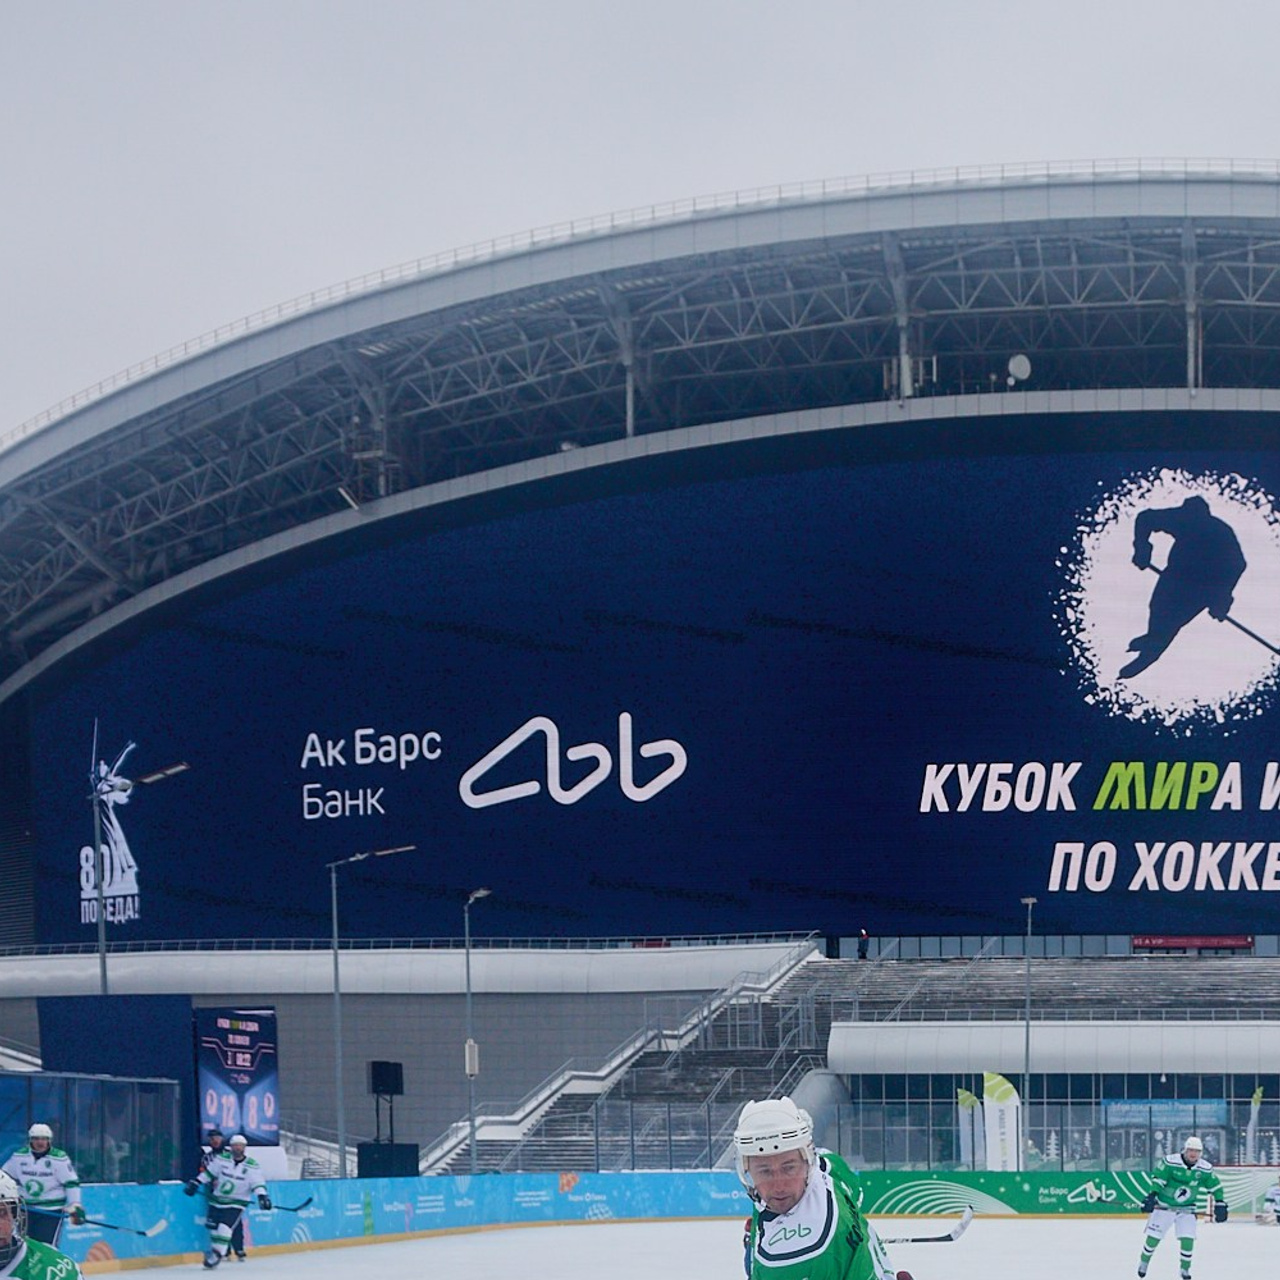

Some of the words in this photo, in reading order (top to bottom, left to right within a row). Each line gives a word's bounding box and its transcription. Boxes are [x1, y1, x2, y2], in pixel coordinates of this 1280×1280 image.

[300, 732, 347, 768] Ак
[354, 727, 442, 769] Барс
[303, 783, 385, 819] Банк
[919, 761, 1082, 812] КУБОК
[1093, 761, 1242, 812] МИРА
[1047, 842, 1118, 892] ПО
